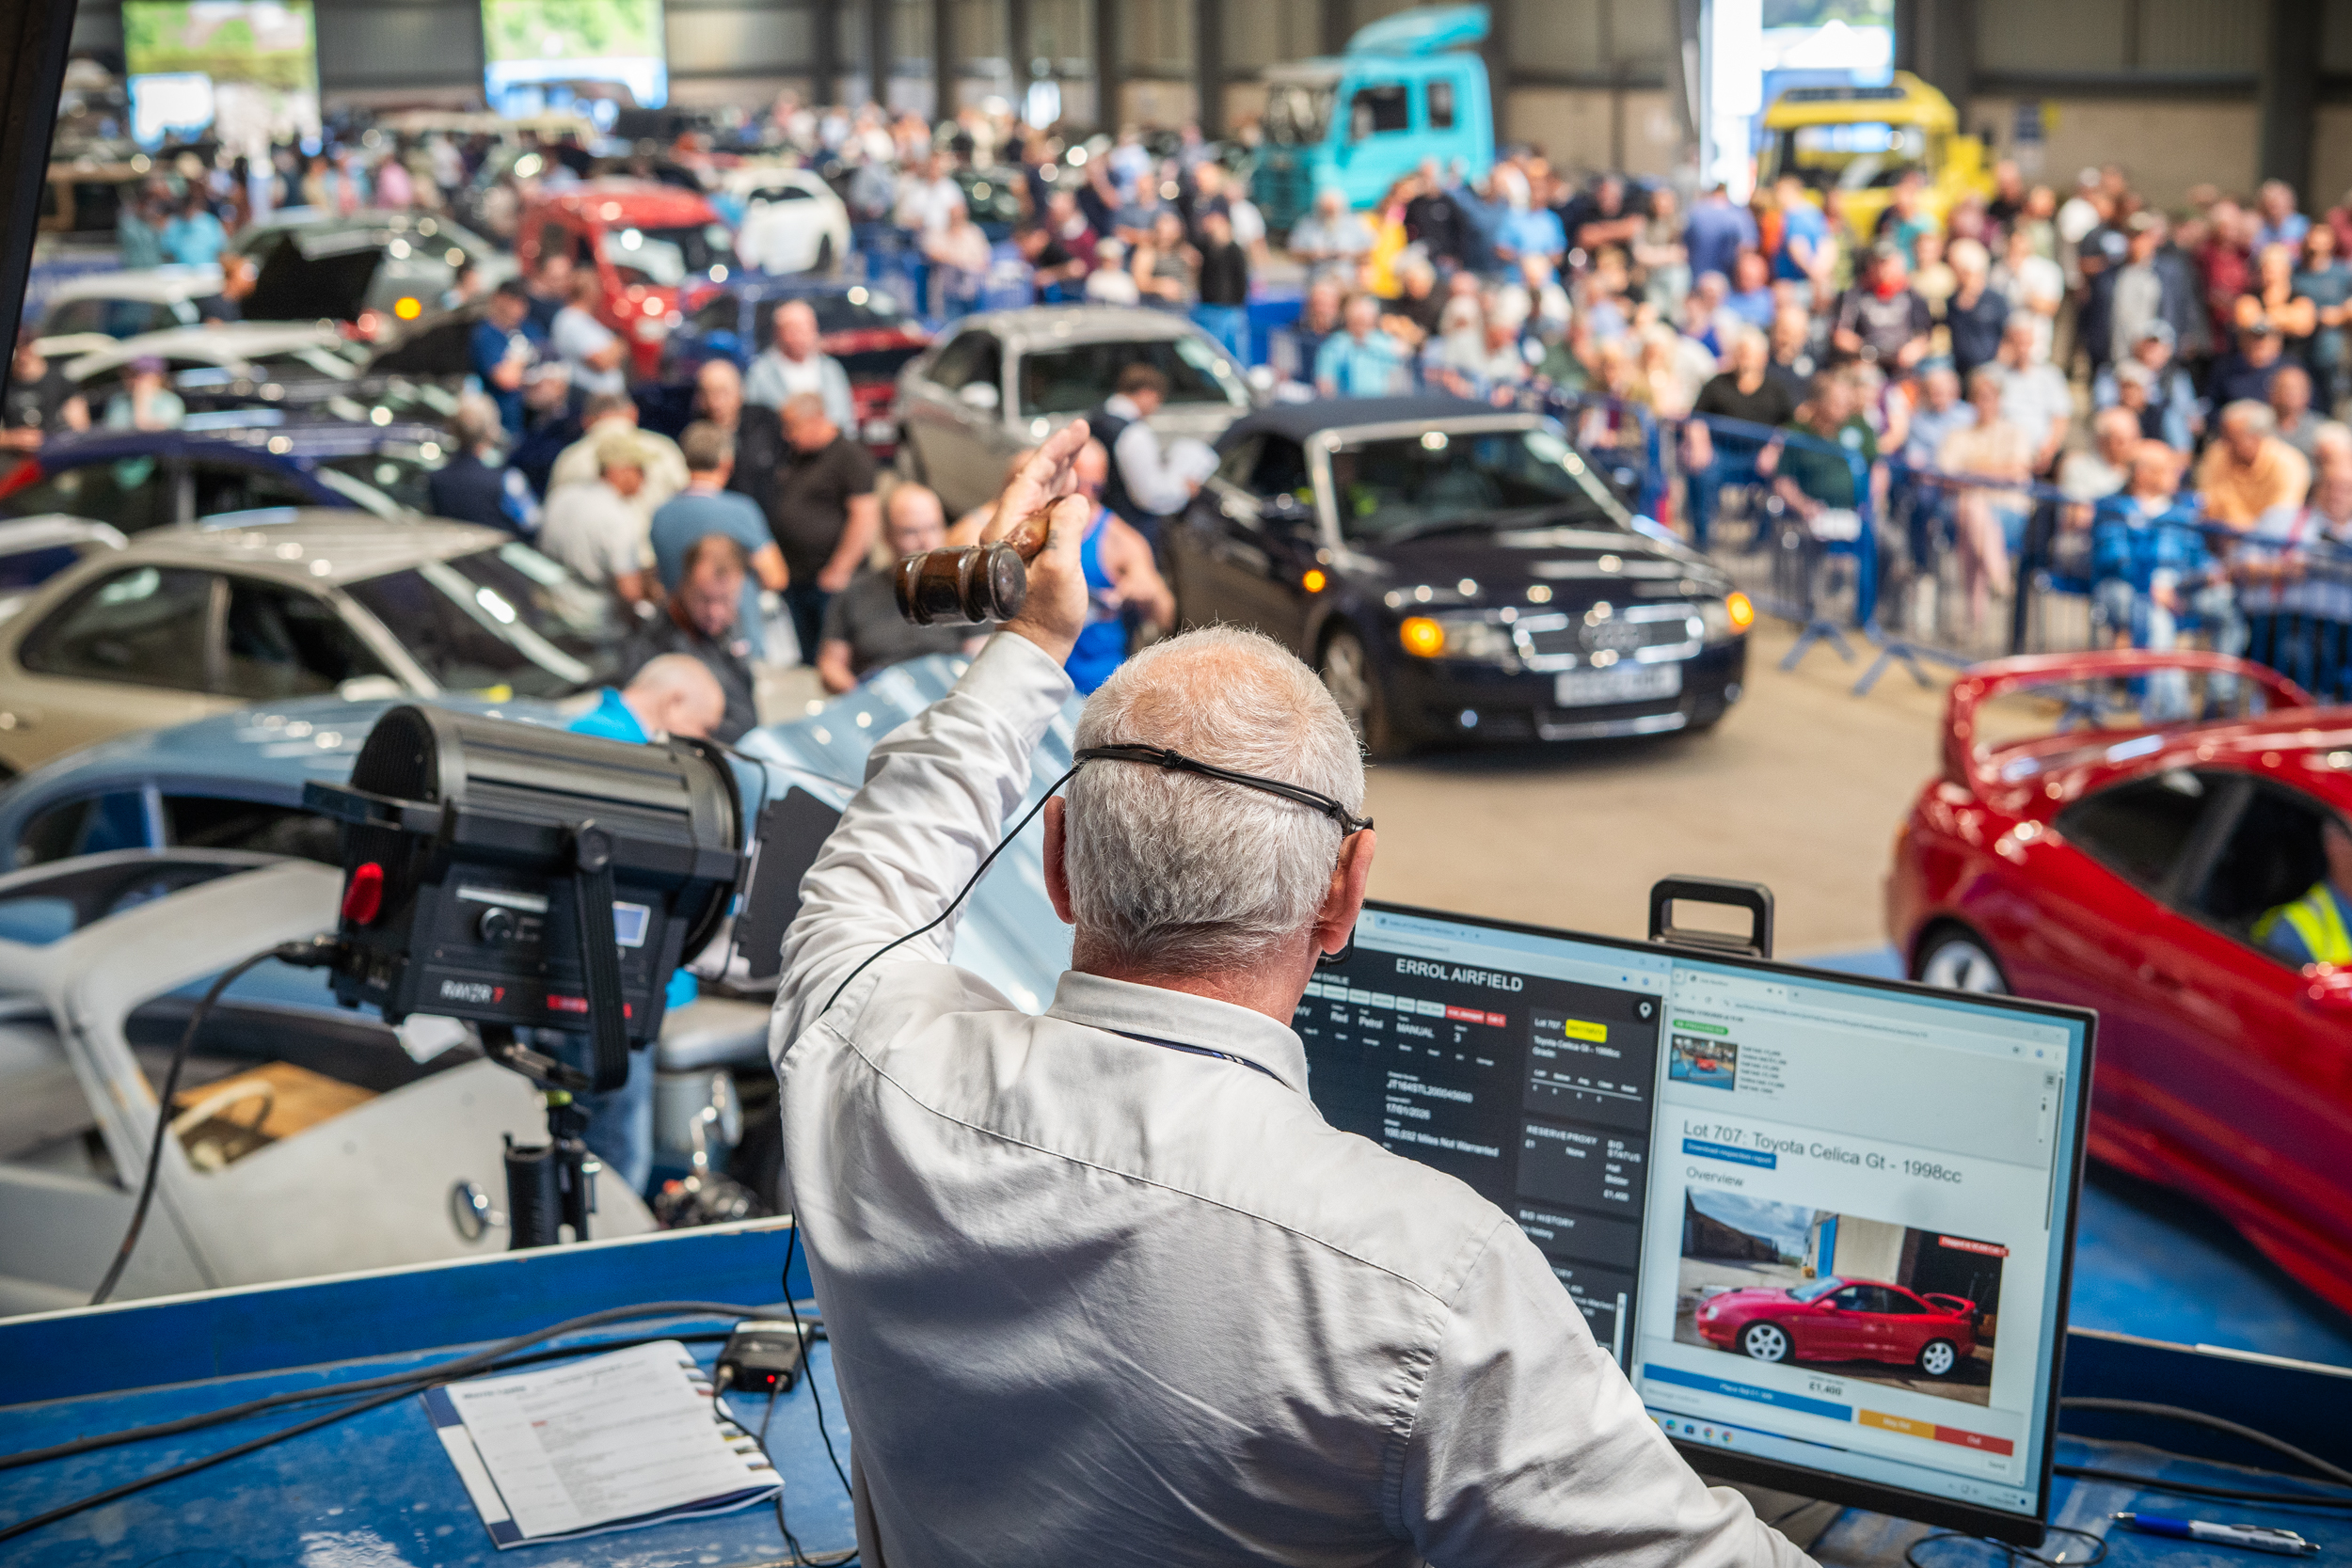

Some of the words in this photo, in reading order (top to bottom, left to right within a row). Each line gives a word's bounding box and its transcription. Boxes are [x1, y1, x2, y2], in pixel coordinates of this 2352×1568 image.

[1395, 958, 1449, 981] ERROL
[1451, 967, 1523, 992] AIRFIELD
[1396, 1022, 1435, 1039] MANUAL
[1526, 1124, 1566, 1141] RESERVE
[1566, 1132, 1598, 1146] PROXY
[1456, 1140, 1500, 1158] Warranted
[1683, 1119, 1708, 1137] Lot
[1713, 1124, 1748, 1146] 707:
[1752, 1132, 1804, 1156] Toyota
[1809, 1142, 1860, 1165] Celica
[1866, 1152, 1886, 1170] Gt
[1903, 1159, 1963, 1184] 1998cc
[1686, 1165, 1744, 1186] Overview
[1518, 1209, 1536, 1222] BID
[1536, 1213, 1576, 1228] HISTORY
[1809, 1381, 1843, 1397] £1,400
